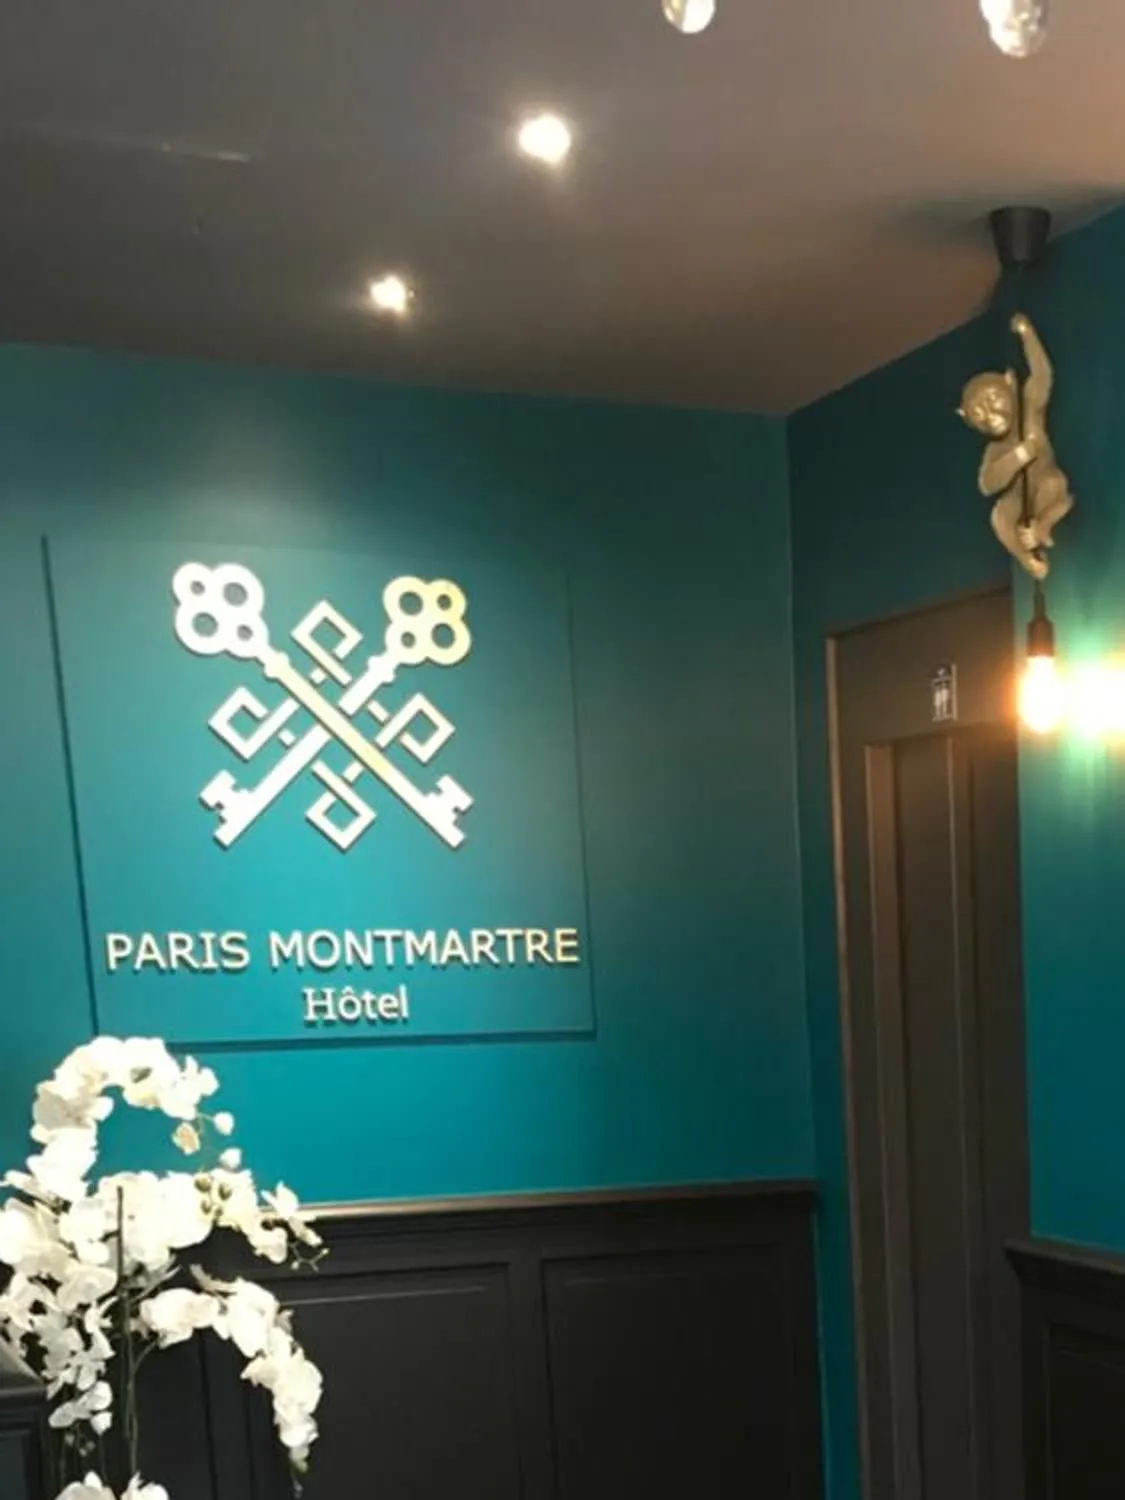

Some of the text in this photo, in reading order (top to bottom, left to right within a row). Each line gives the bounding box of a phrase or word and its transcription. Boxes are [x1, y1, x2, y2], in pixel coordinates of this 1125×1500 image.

[106, 928, 581, 971] PARIS MONTMARTRE
[302, 985, 409, 1021] Hôtel
